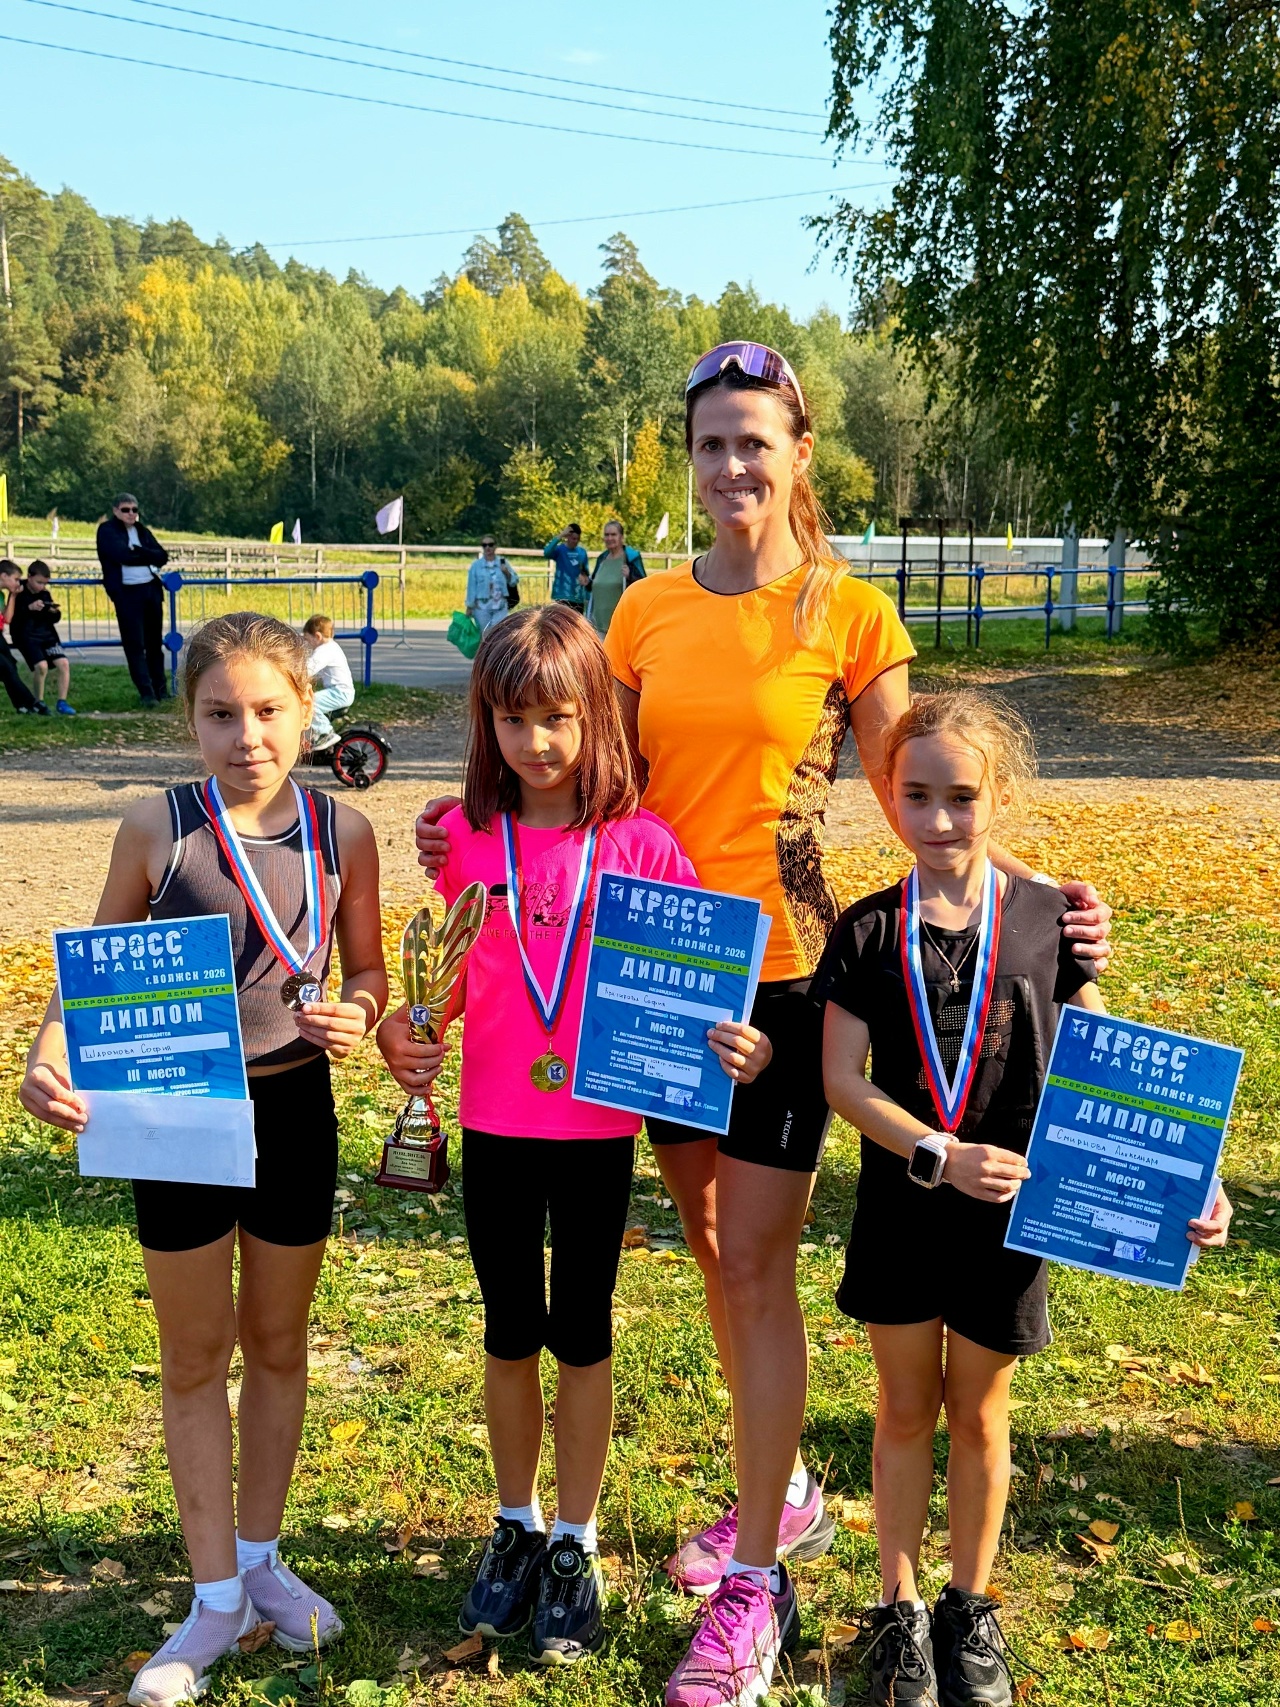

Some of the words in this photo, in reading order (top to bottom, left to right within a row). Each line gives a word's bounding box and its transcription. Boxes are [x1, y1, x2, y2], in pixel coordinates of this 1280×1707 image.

[629, 887, 713, 924] КРОСС
[530, 931, 550, 939] THE
[628, 911, 711, 937] НАЦИИ
[91, 930, 182, 961] КРОСС
[671, 937, 720, 954] г.ВОЛЖСК
[724, 946, 746, 959] 2026
[94, 956, 184, 974] НАЦИИ
[146, 971, 199, 985] г.ВОЛЖСК
[203, 968, 226, 980] 2026
[620, 956, 716, 993] ДИПЛОМ
[100, 1003, 203, 1034] ДИПЛОМ
[650, 1021, 685, 1039] место
[1092, 1025, 1189, 1070] КРОСС
[127, 1069, 140, 1082] III
[147, 1066, 186, 1080] место
[1089, 1051, 1184, 1085] НАЦИИ
[1055, 1078, 1145, 1106] ВСЕРОССИЙСКИЙ
[1137, 1082, 1195, 1104] г.ВОЛЖСК
[1197, 1096, 1223, 1111] 2026
[1075, 1099, 1186, 1145] ДИПЛОМ
[1086, 1164, 1097, 1177] II
[1105, 1171, 1146, 1191] место
